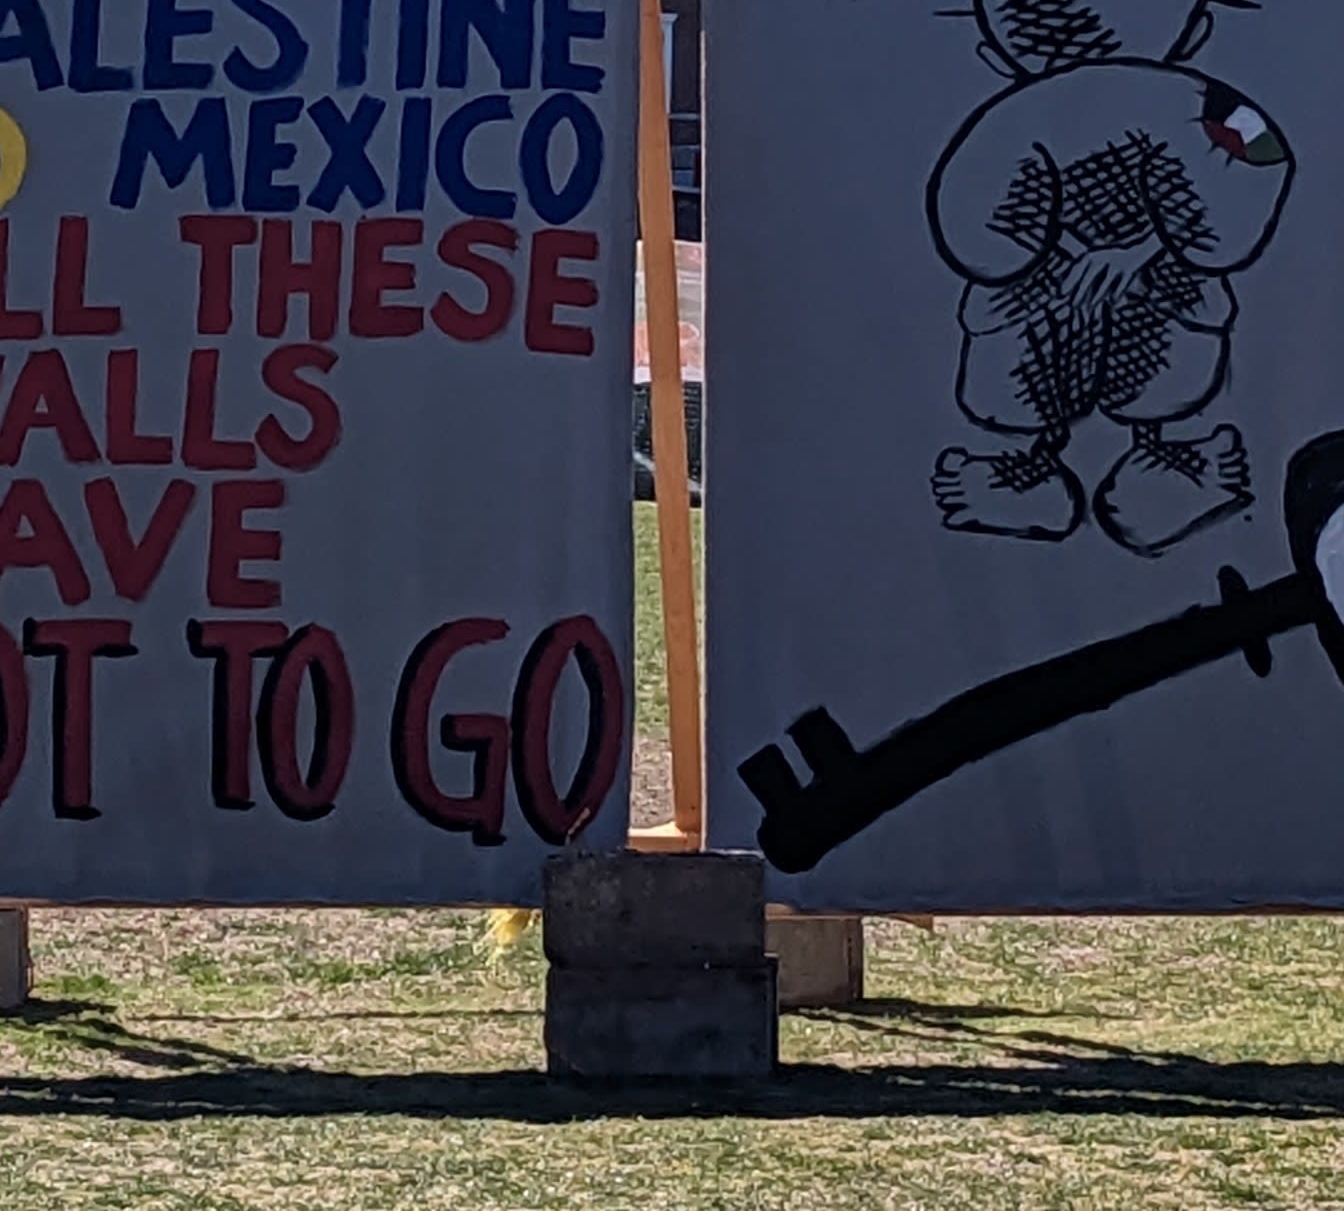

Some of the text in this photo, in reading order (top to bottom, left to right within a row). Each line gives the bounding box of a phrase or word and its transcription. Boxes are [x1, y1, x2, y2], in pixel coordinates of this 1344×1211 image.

[109, 91, 605, 226] MEXICO
[178, 213, 601, 357] THESE
[186, 618, 355, 822] TO
[390, 612, 625, 847] GO
